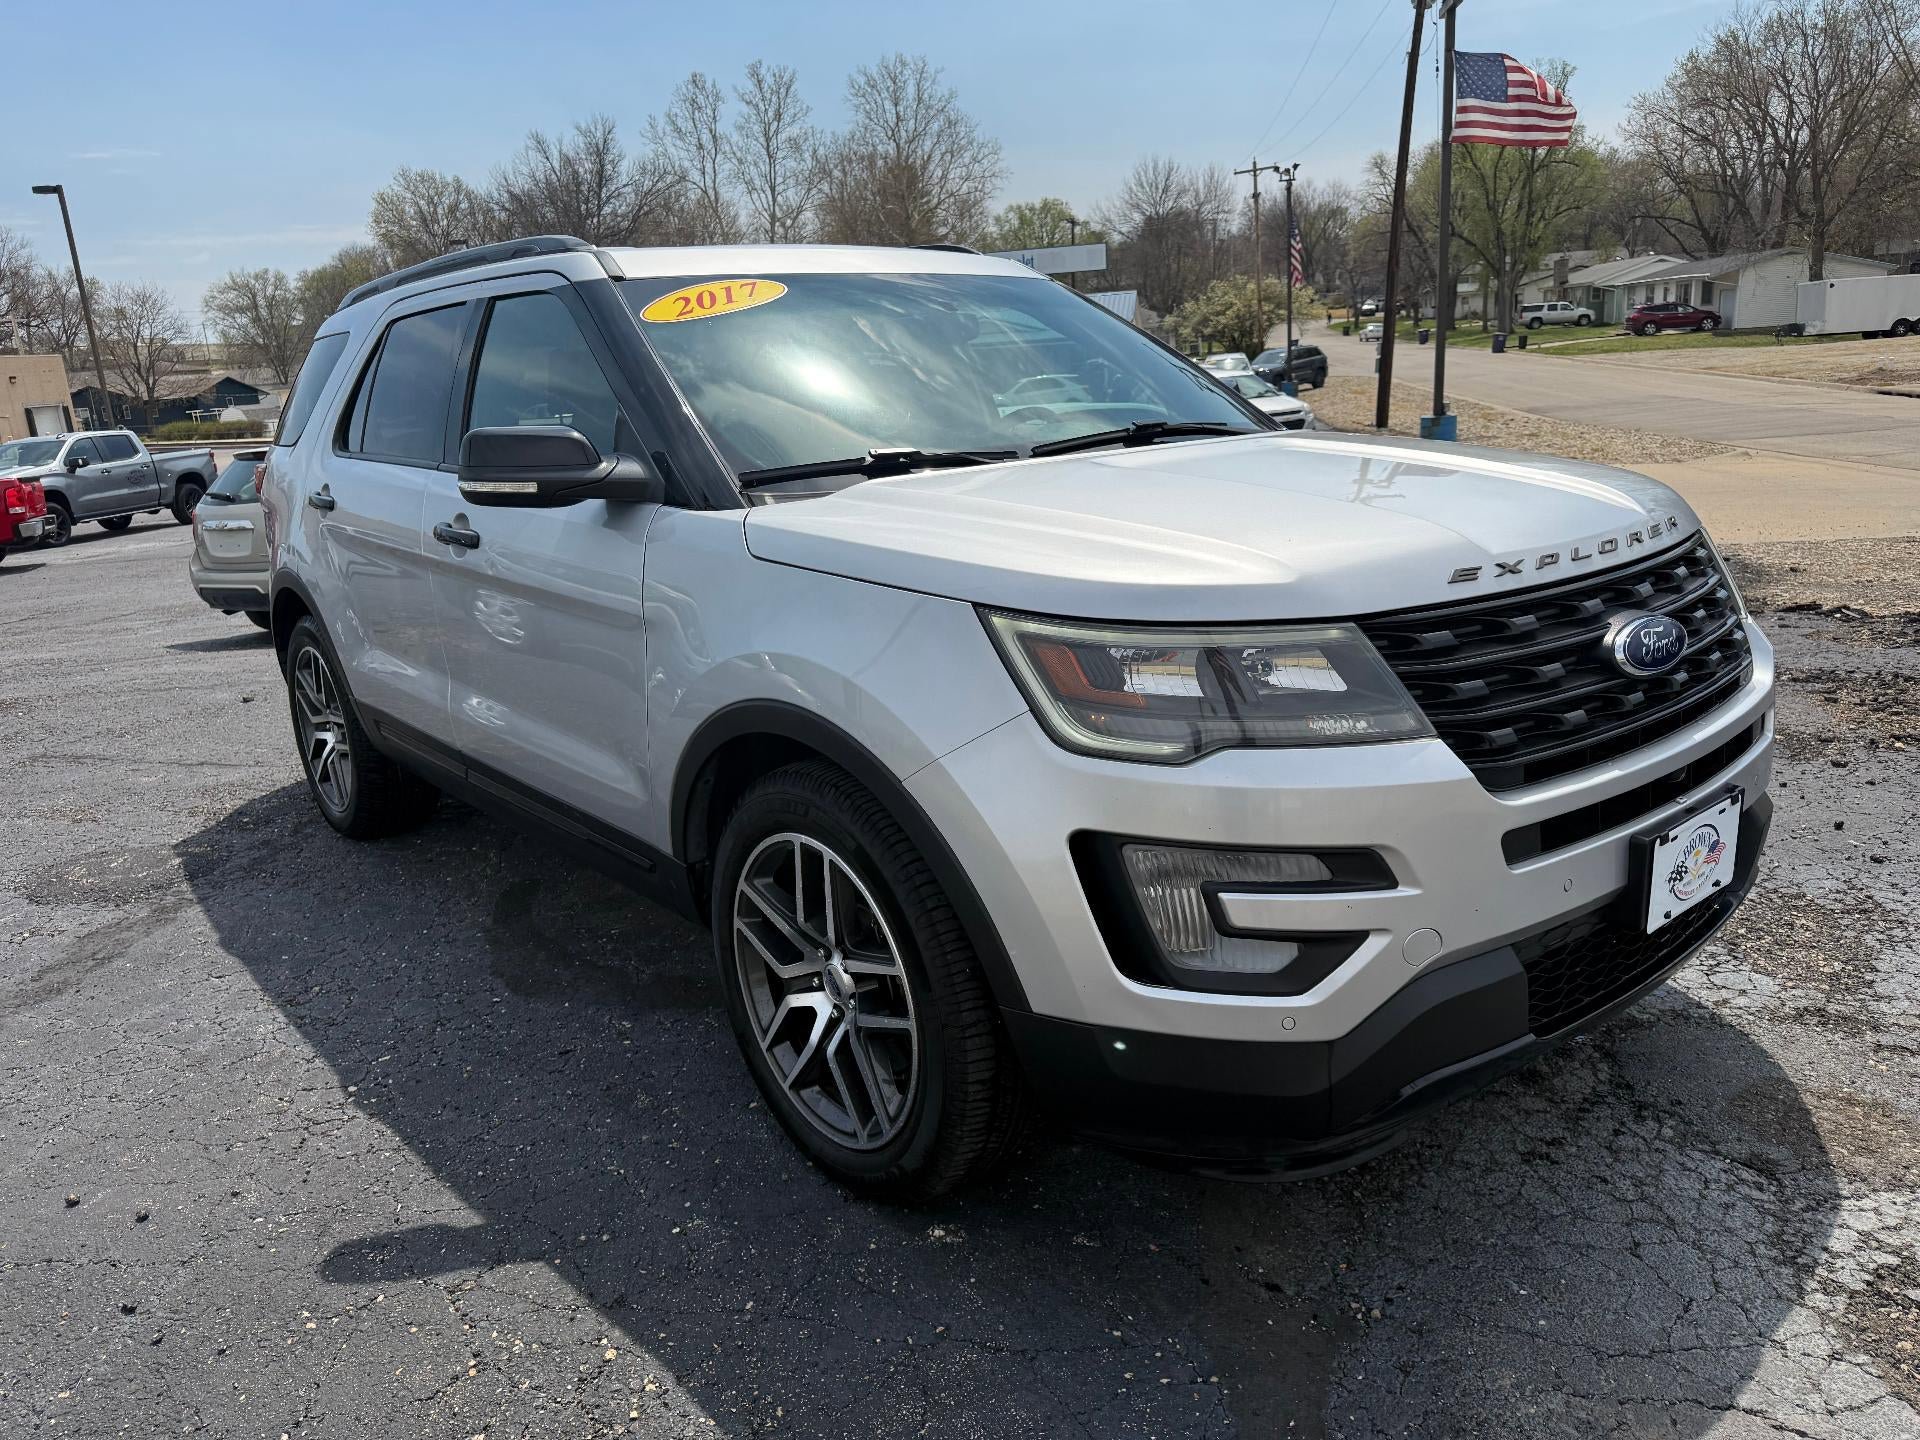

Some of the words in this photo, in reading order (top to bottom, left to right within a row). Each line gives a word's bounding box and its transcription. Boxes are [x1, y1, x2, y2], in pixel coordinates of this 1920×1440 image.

[673, 281, 758, 318] 2017
[1447, 515, 1680, 584] EXPLORER
[1640, 624, 1679, 662] Ford
